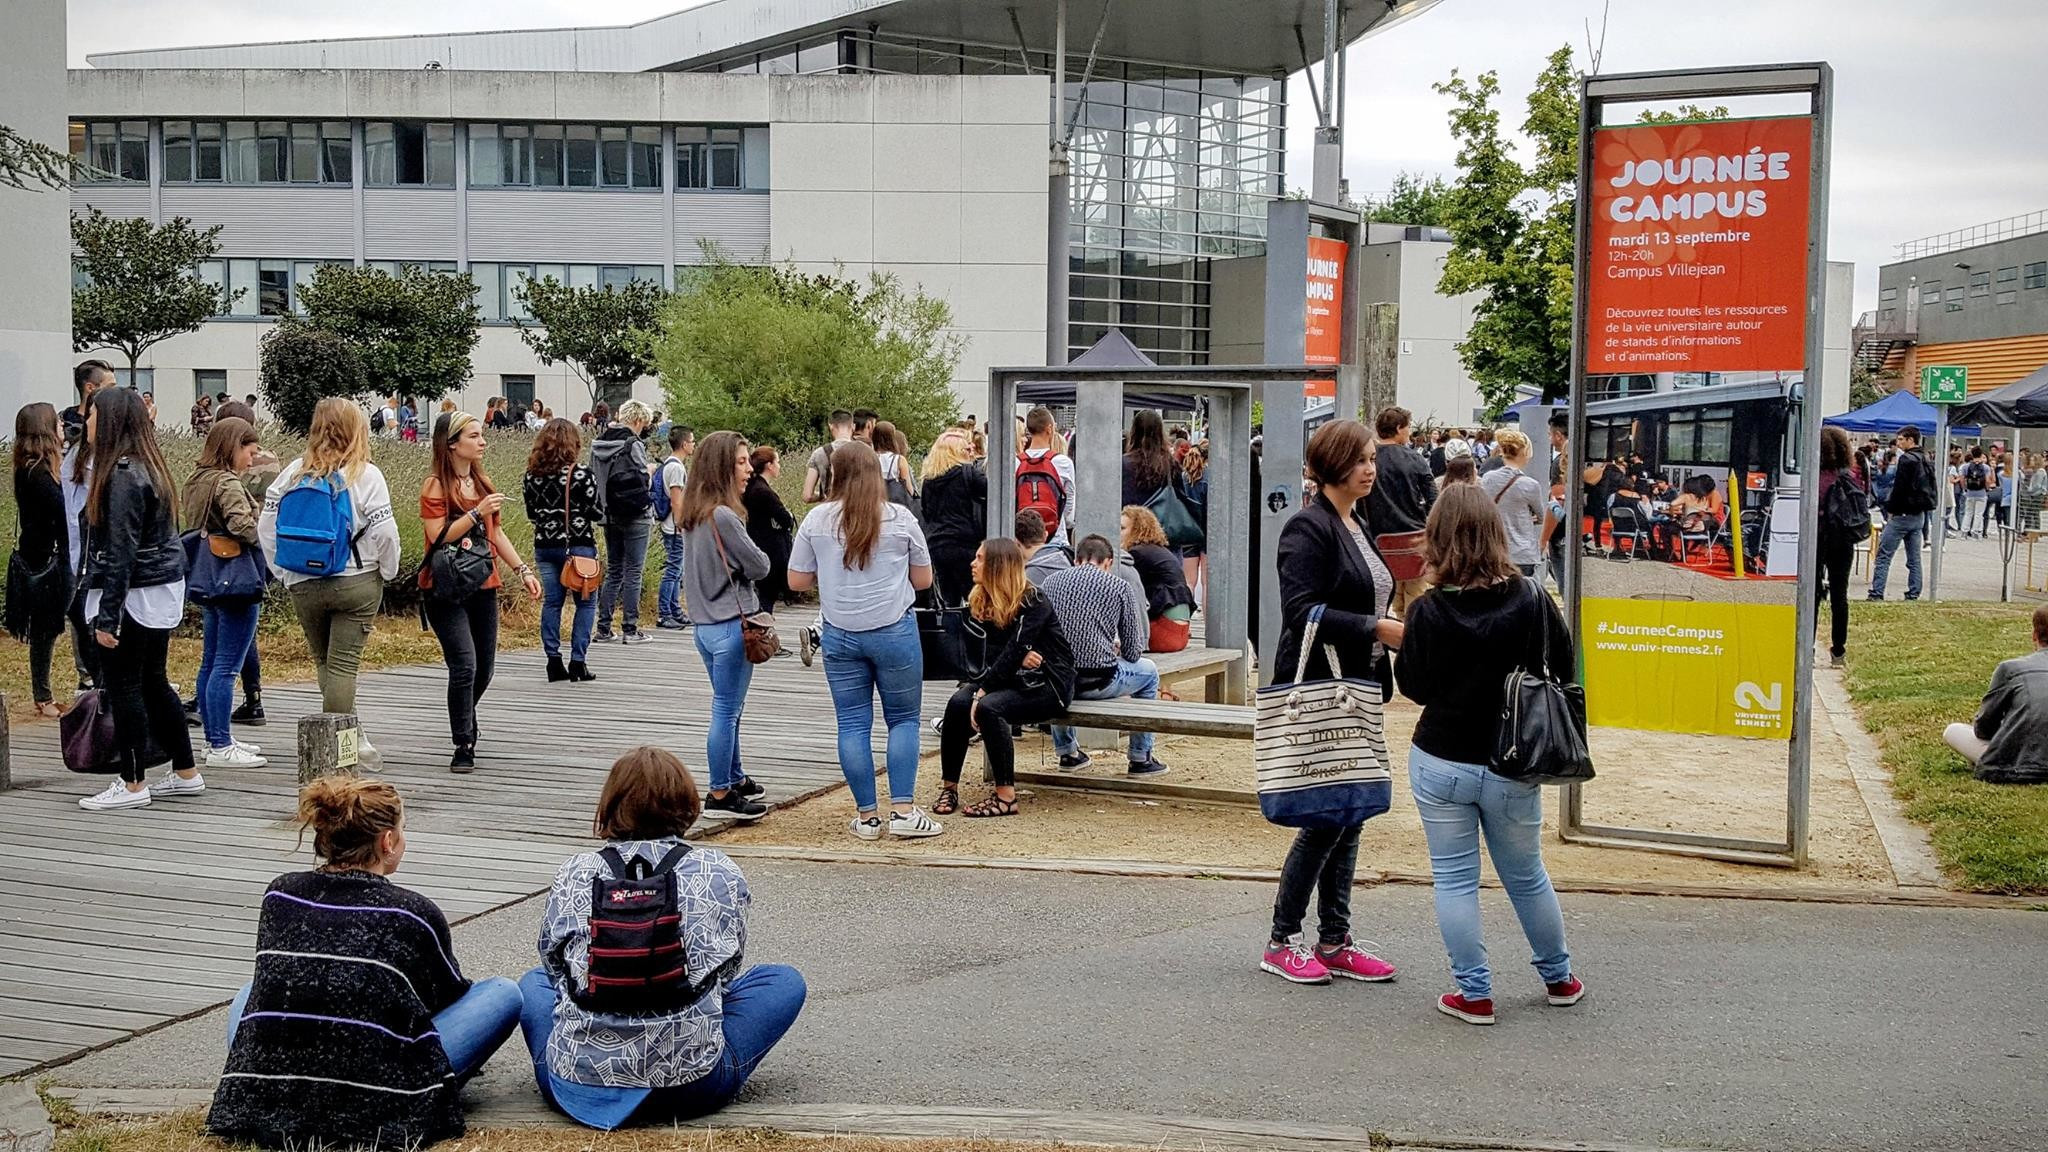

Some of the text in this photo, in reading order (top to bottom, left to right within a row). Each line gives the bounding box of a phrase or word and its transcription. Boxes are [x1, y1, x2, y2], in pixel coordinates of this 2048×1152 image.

[1610, 146, 1791, 188] JOURNÉE
[1610, 190, 1767, 222] CAMPUS
[1609, 229, 1751, 247] mardi 13 septembre
[1608, 250, 1654, 262] 12h-20h
[1607, 263, 1725, 280] Campus Villejean
[1606, 304, 1788, 318] Découvrez toutes les ressources
[1606, 320, 1763, 333] de la vie universitaire autour
[1605, 335, 1741, 347] de stands d'informations
[1605, 350, 1691, 362] et d'animations.
[1597, 621, 1723, 641] #JourneeCampus
[1596, 641, 1724, 655] www.univ-rennes2.fr
